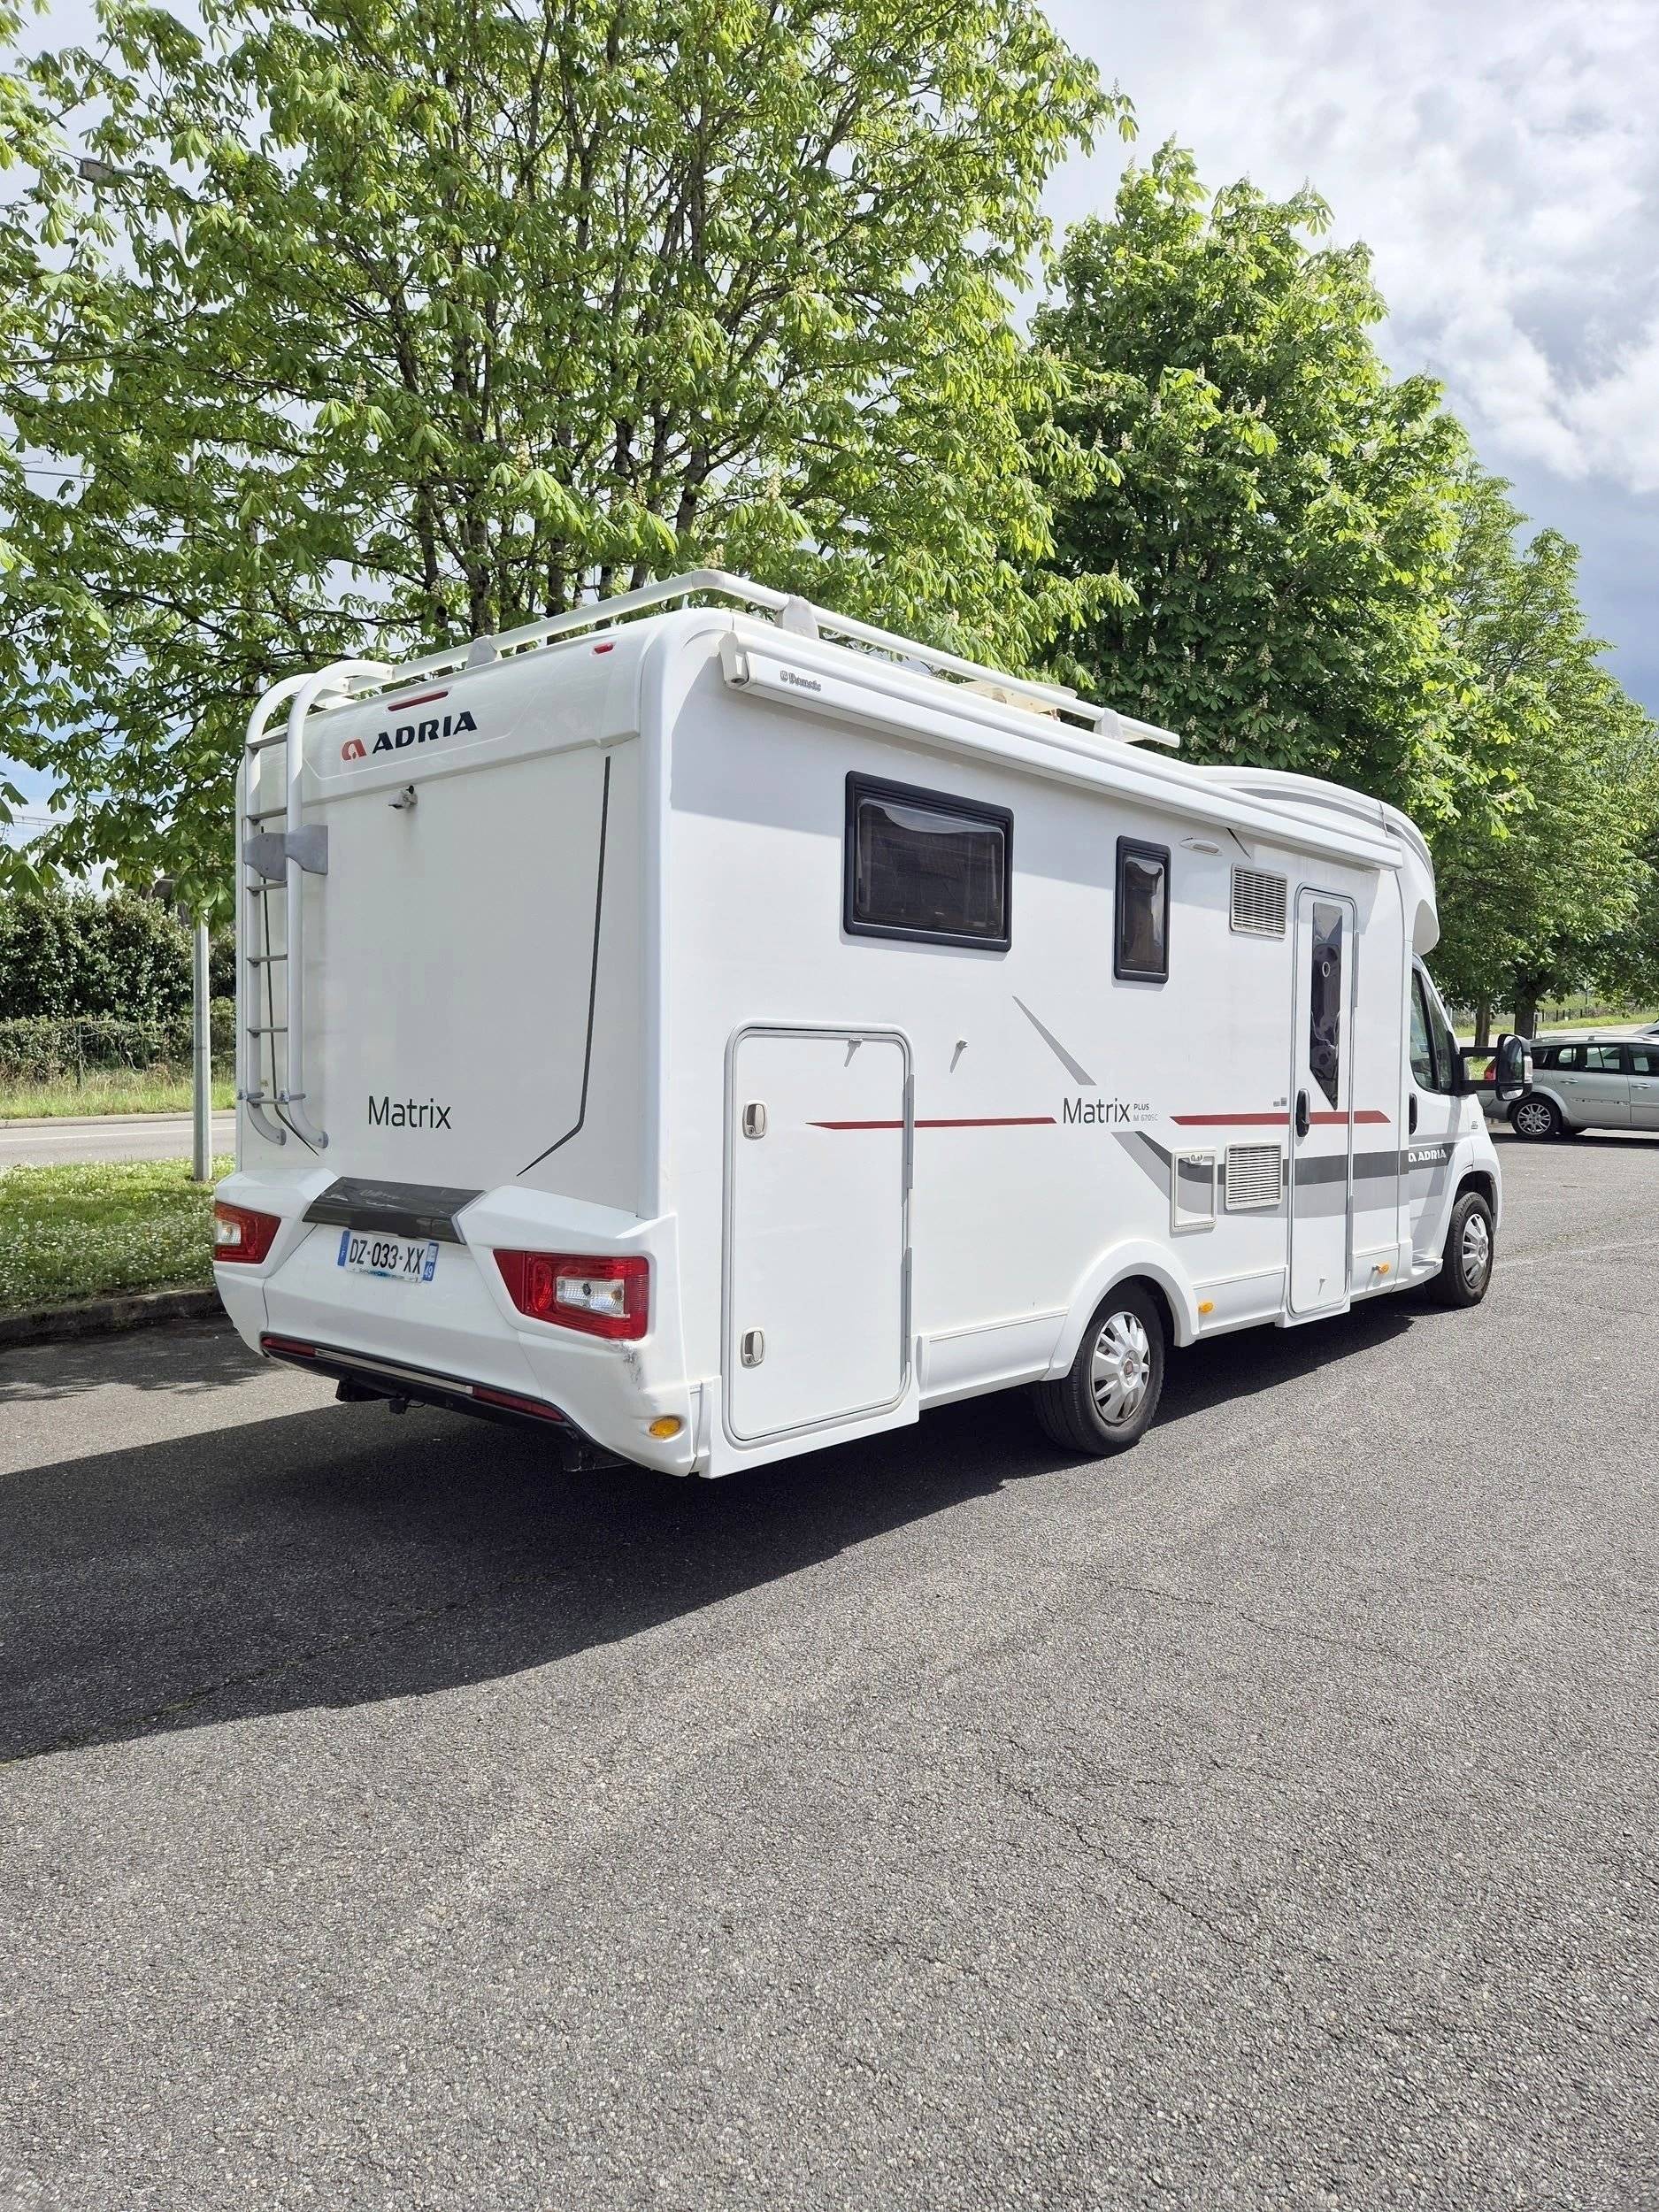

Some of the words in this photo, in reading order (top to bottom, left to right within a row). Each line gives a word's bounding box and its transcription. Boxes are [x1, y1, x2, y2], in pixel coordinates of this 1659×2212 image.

[372, 710, 478, 755] ADRIA
[368, 1095, 452, 1130] Matrix
[1063, 1097, 1132, 1125] Matrix
[1417, 1148, 1447, 1162] ADRIA
[349, 1238, 425, 1275] DZ-033-XX
